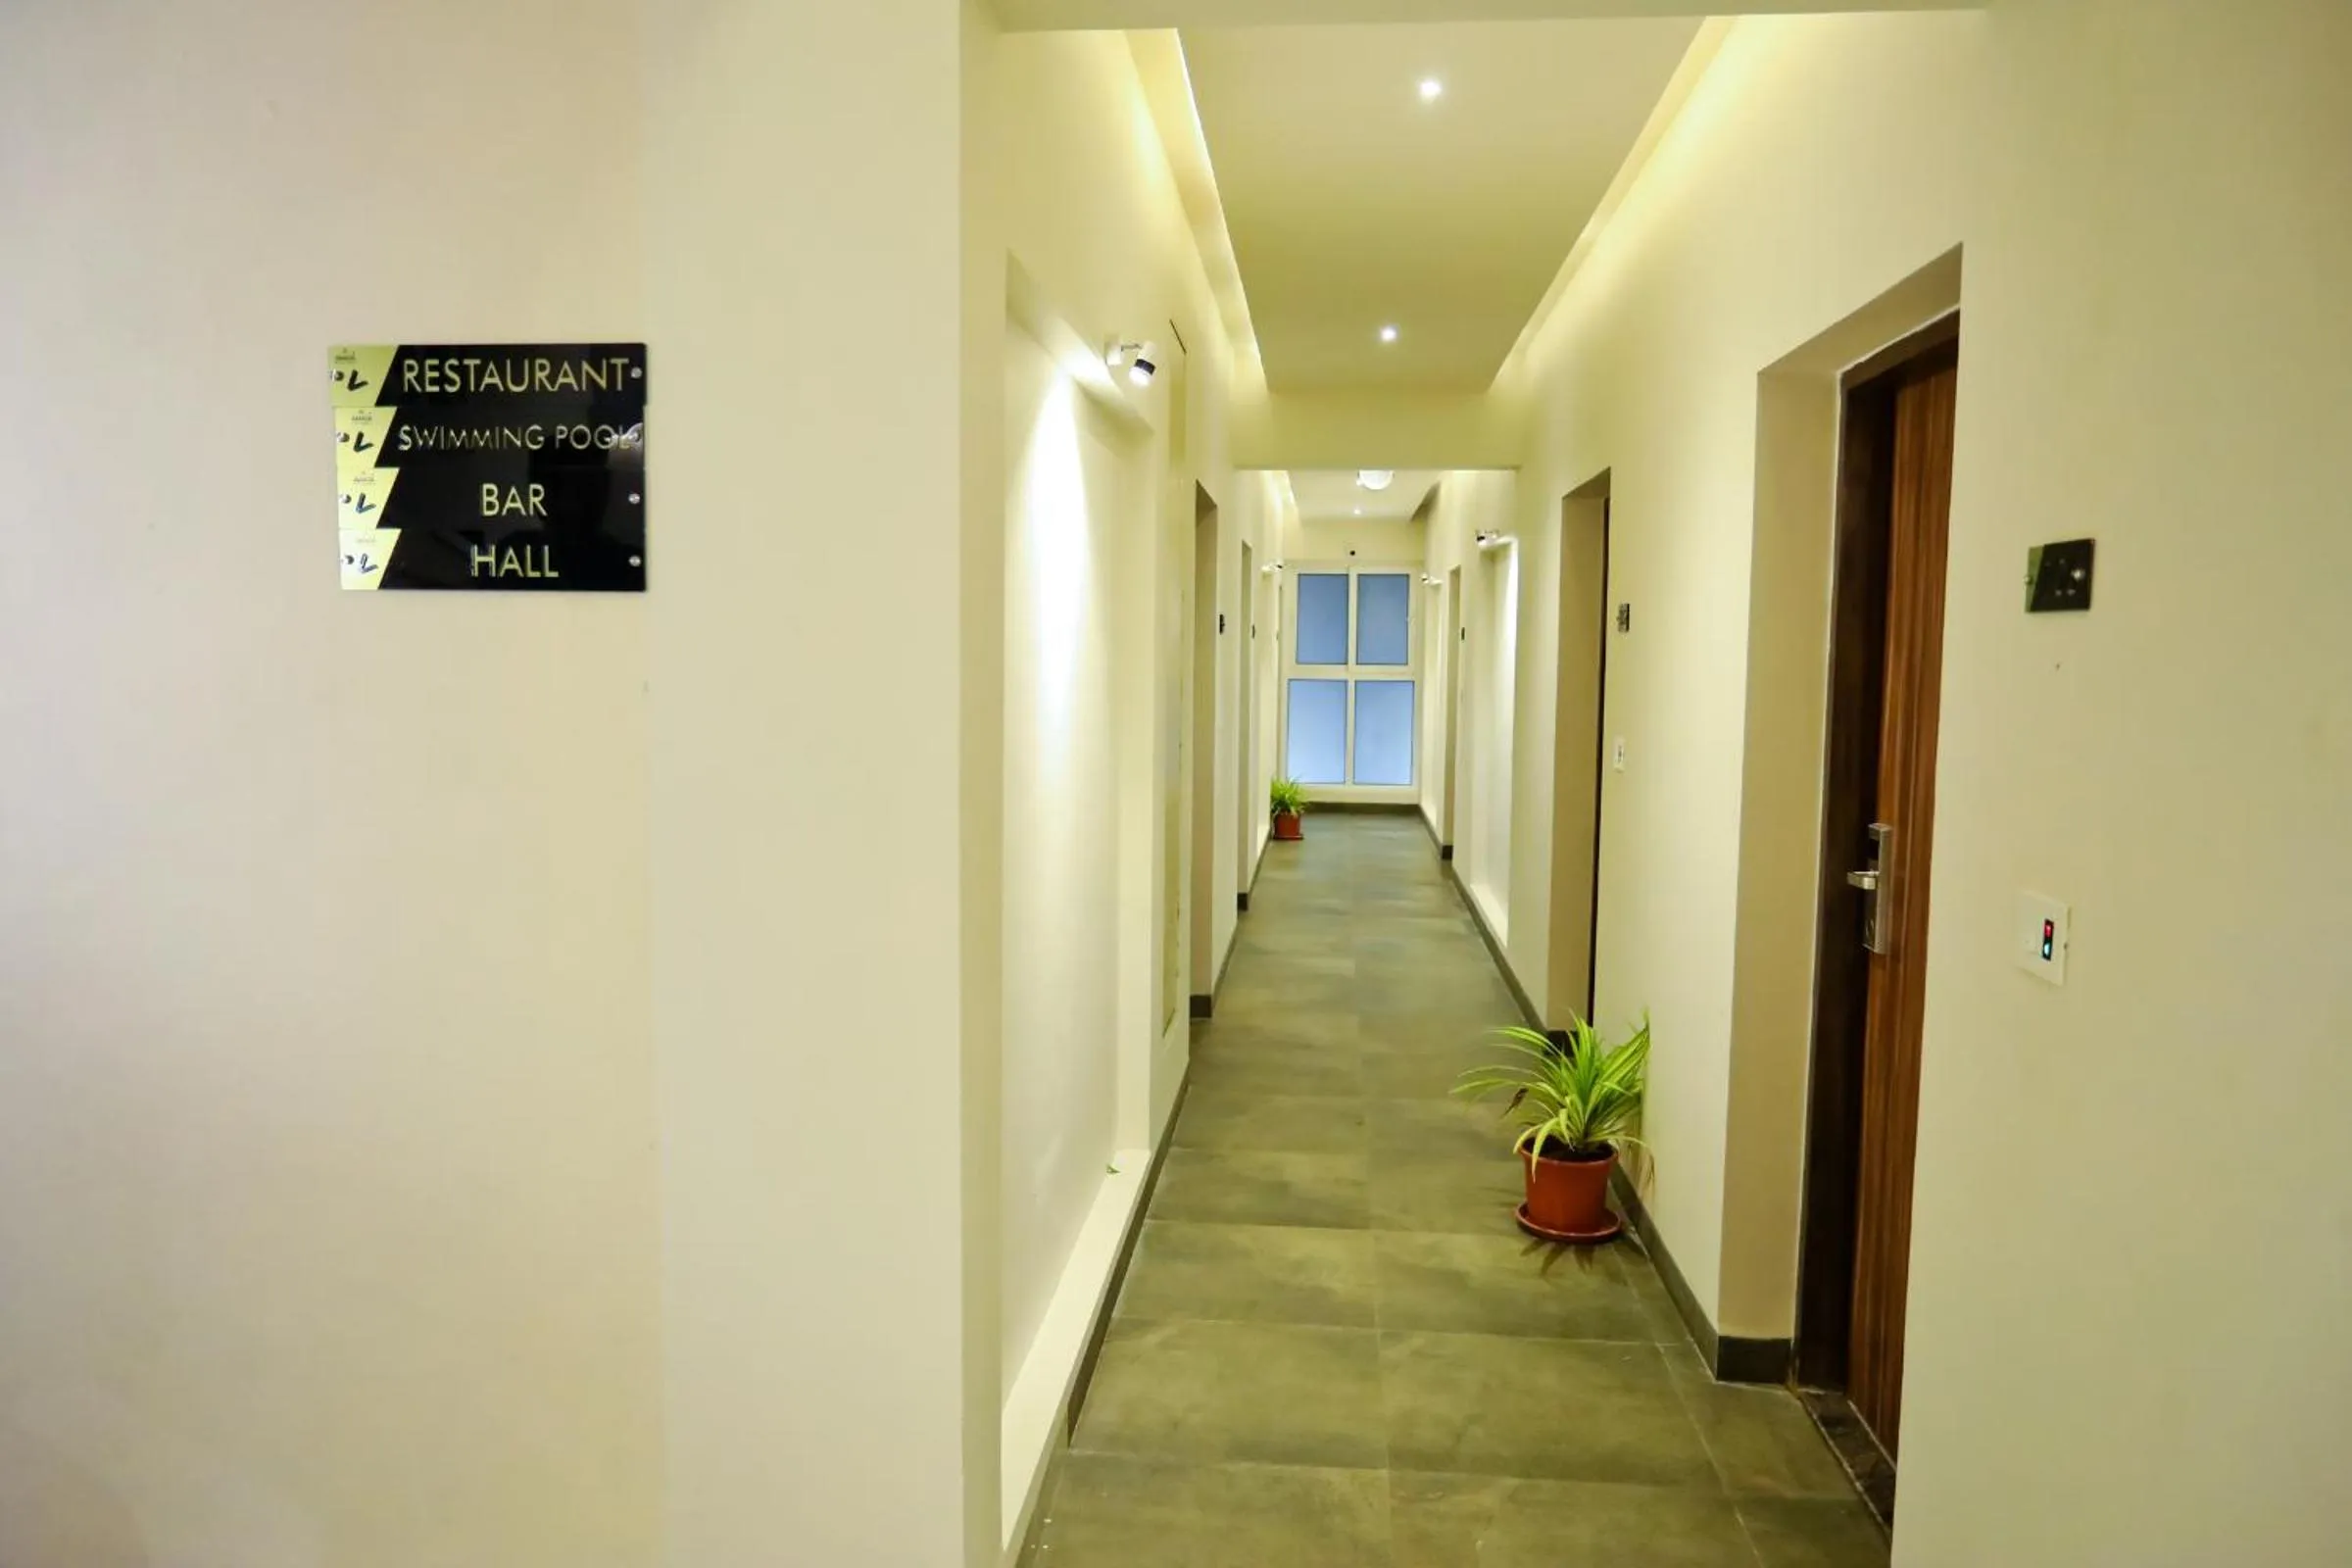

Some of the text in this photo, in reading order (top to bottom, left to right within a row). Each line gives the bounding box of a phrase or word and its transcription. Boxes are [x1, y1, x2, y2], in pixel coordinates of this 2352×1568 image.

[404, 359, 628, 392] RESTAURANT
[398, 424, 630, 451] SWIMMING POOL
[481, 484, 547, 516] BAR
[471, 545, 559, 577] HALL
